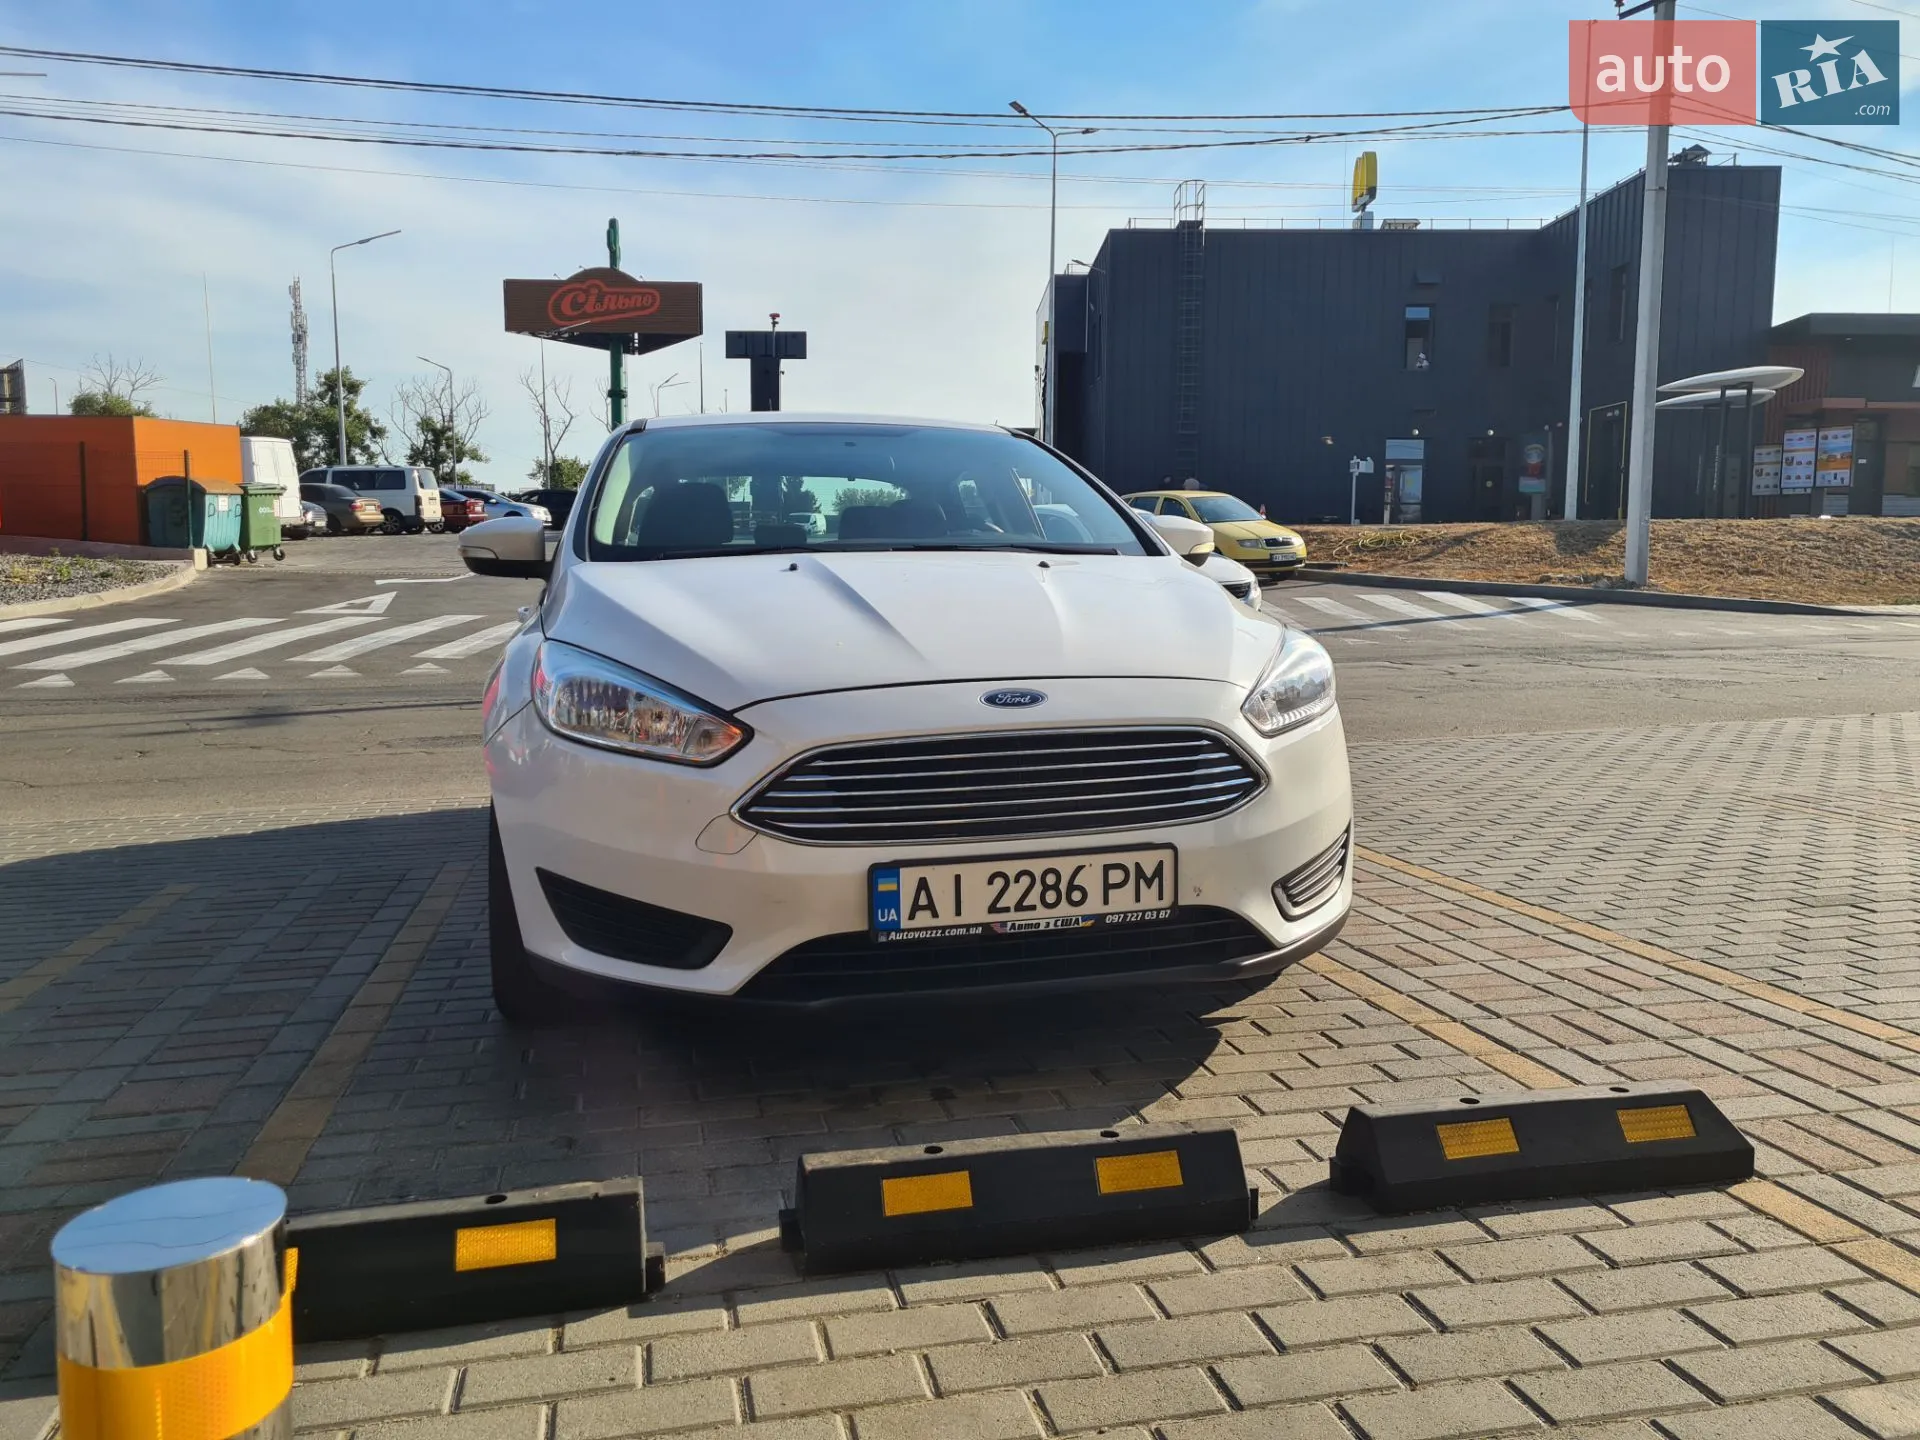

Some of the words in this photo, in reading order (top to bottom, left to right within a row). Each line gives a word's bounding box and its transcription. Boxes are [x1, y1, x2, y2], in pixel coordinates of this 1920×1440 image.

[561, 286, 652, 316] Сільпо
[995, 693, 1032, 704] Ford
[907, 873, 962, 921] AI
[987, 864, 1089, 915] 2286
[1102, 860, 1164, 906] PM
[878, 909, 898, 922] UA
[1053, 917, 1081, 928] США
[1105, 914, 1123, 924] 097
[1126, 912, 1142, 922] 727
[1159, 909, 1171, 919] 87
[888, 926, 983, 941] Autovozzz.com.ua
